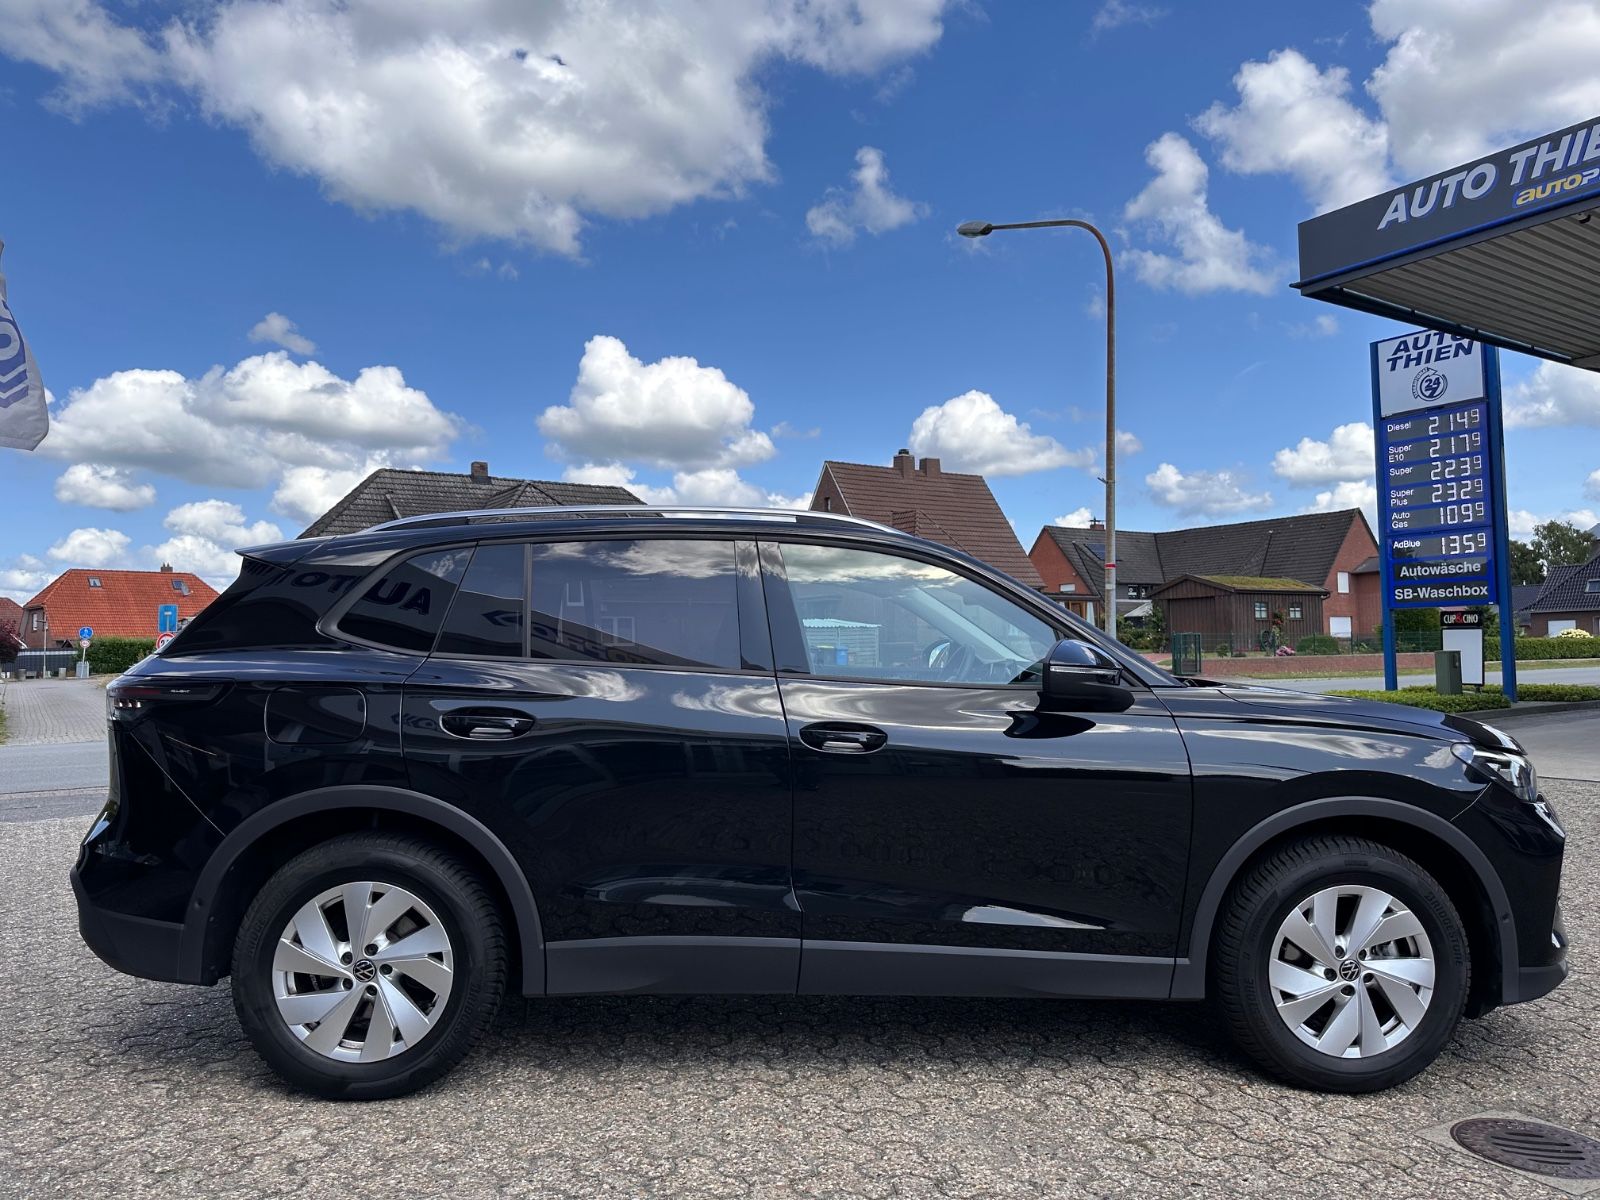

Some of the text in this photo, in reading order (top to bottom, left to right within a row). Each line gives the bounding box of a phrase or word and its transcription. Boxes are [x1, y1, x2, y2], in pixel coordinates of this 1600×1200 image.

[1376, 162, 1497, 231] AUTO
[1386, 340, 1474, 372] THIEN
[1387, 421, 1412, 432] Diesel
[1388, 444, 1412, 455] Super
[1388, 454, 1405, 463] E10
[1389, 466, 1413, 477] Super
[1390, 489, 1414, 499] Super
[1390, 498, 1408, 507] Plus
[1392, 511, 1410, 521] Auto
[1392, 520, 1408, 529] Gas
[1393, 539, 1421, 549] AdBlue
[1400, 561, 1481, 578] Autowäsche
[1394, 585, 1488, 600] SB-Waschbox
